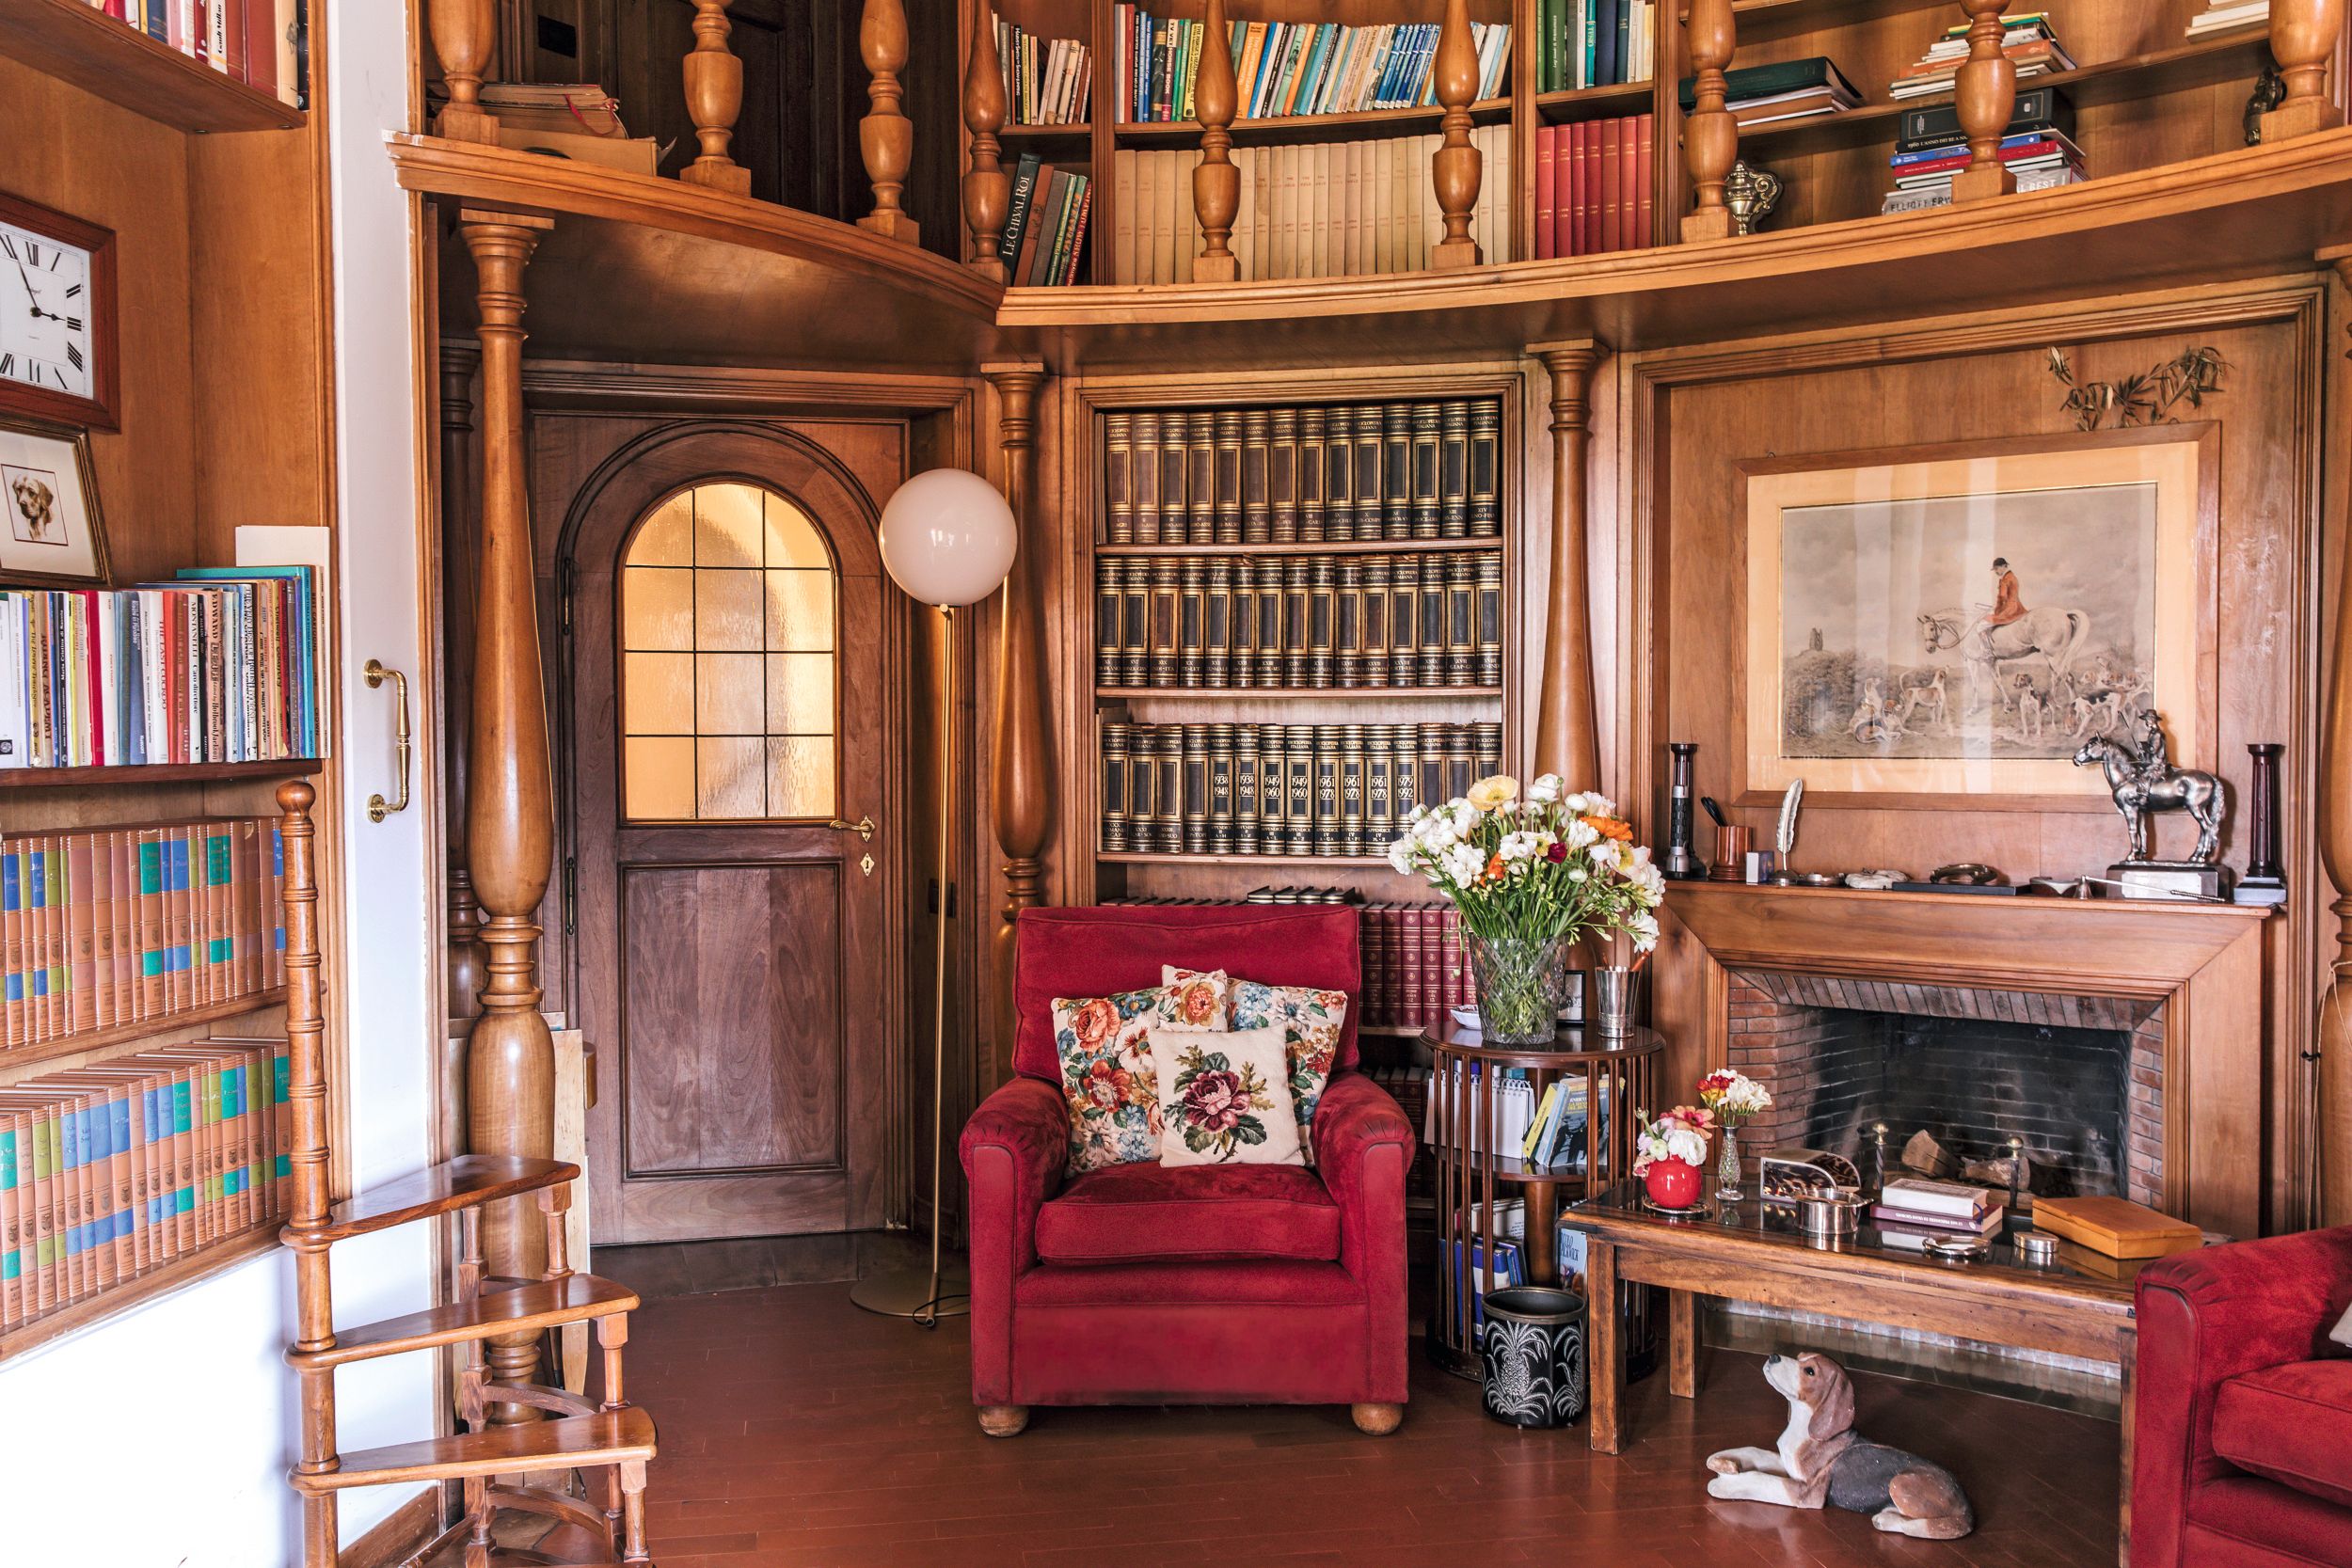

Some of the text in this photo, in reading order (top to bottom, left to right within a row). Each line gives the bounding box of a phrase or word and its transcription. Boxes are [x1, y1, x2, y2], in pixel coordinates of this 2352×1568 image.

[1015, 176, 1029, 198] ROI
[2029, 180, 2056, 191] BEST
[1891, 198, 1929, 212] ELLIOTT
[43, 684, 52, 738] ACADEMY
[1214, 775, 1228, 784] 1938
[1239, 775, 1254, 784] 1938
[1264, 777, 1279, 785] 1949
[1292, 777, 1307, 786] 1949
[1319, 777, 1334, 786] 1961
[1344, 777, 1360, 786] 1961
[1371, 777, 1387, 786] 1961
[1397, 776, 1413, 785] 1979
[1214, 786, 1228, 796] 1948
[1239, 786, 1254, 795] 1948
[1264, 788, 1279, 798] 1960
[1292, 788, 1307, 798] 1960
[1319, 788, 1334, 799] 1978
[1344, 788, 1360, 799] 1978
[1371, 788, 1387, 799] 1978
[1397, 788, 1413, 797] 1992
